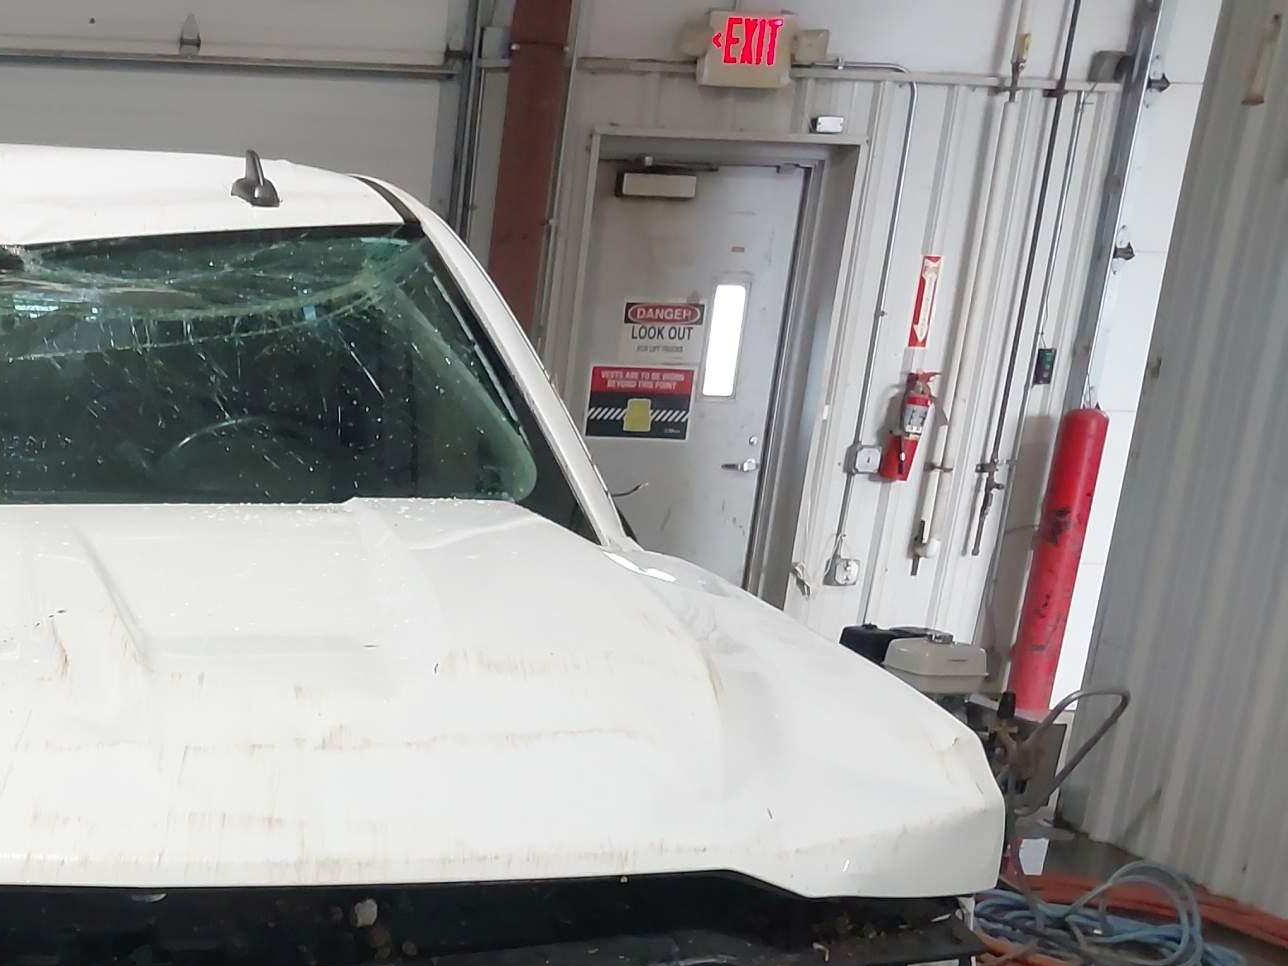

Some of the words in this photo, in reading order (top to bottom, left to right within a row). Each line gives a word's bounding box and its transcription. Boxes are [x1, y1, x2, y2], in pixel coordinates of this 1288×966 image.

[723, 17, 784, 65] EXIT
[636, 308, 692, 320] DANGER
[632, 325, 665, 340] LOOK
[668, 326, 693, 340] OUT
[641, 372, 650, 380] TO
[654, 381, 677, 390] POINT
